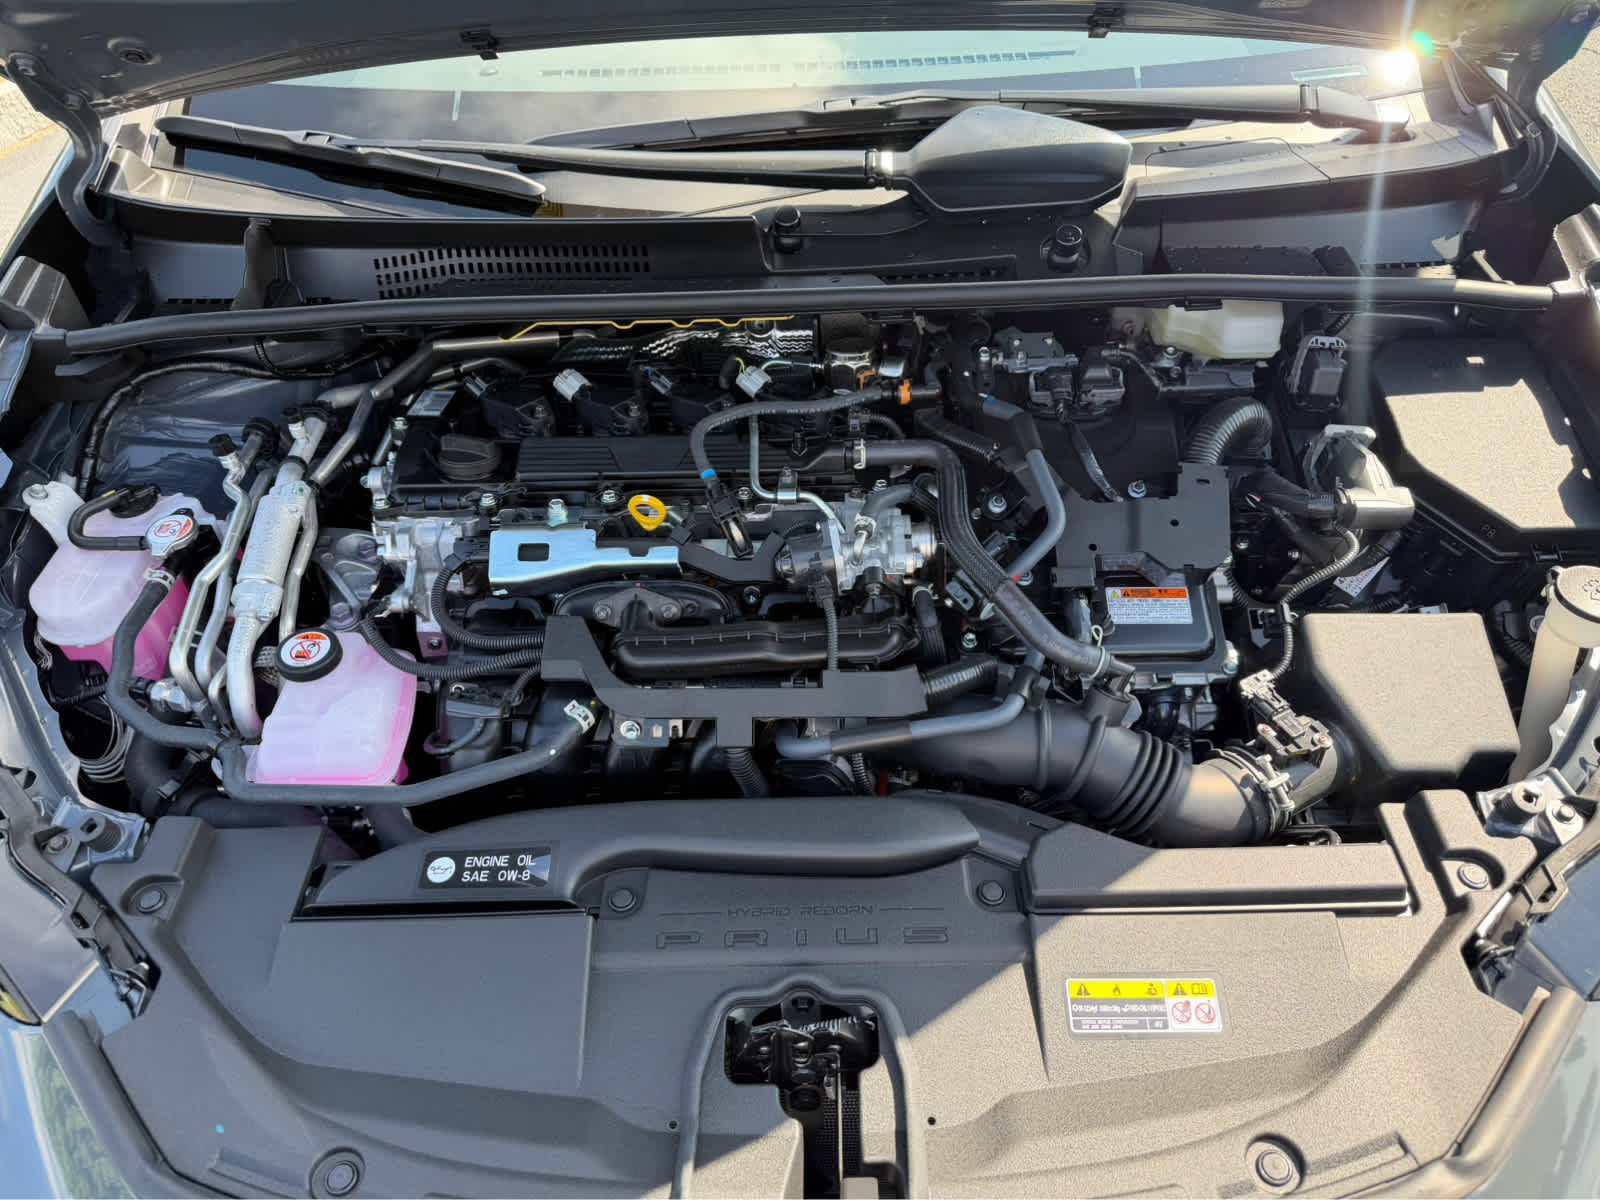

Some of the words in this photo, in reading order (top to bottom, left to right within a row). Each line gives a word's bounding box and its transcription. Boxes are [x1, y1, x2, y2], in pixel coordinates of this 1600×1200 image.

[464, 856, 509, 868] ENGINE
[517, 854, 536, 866] OIL
[461, 870, 489, 882] SAE
[727, 904, 792, 918] HYBRID
[800, 903, 873, 917] REBORN
[656, 926, 949, 949] PRIUS
